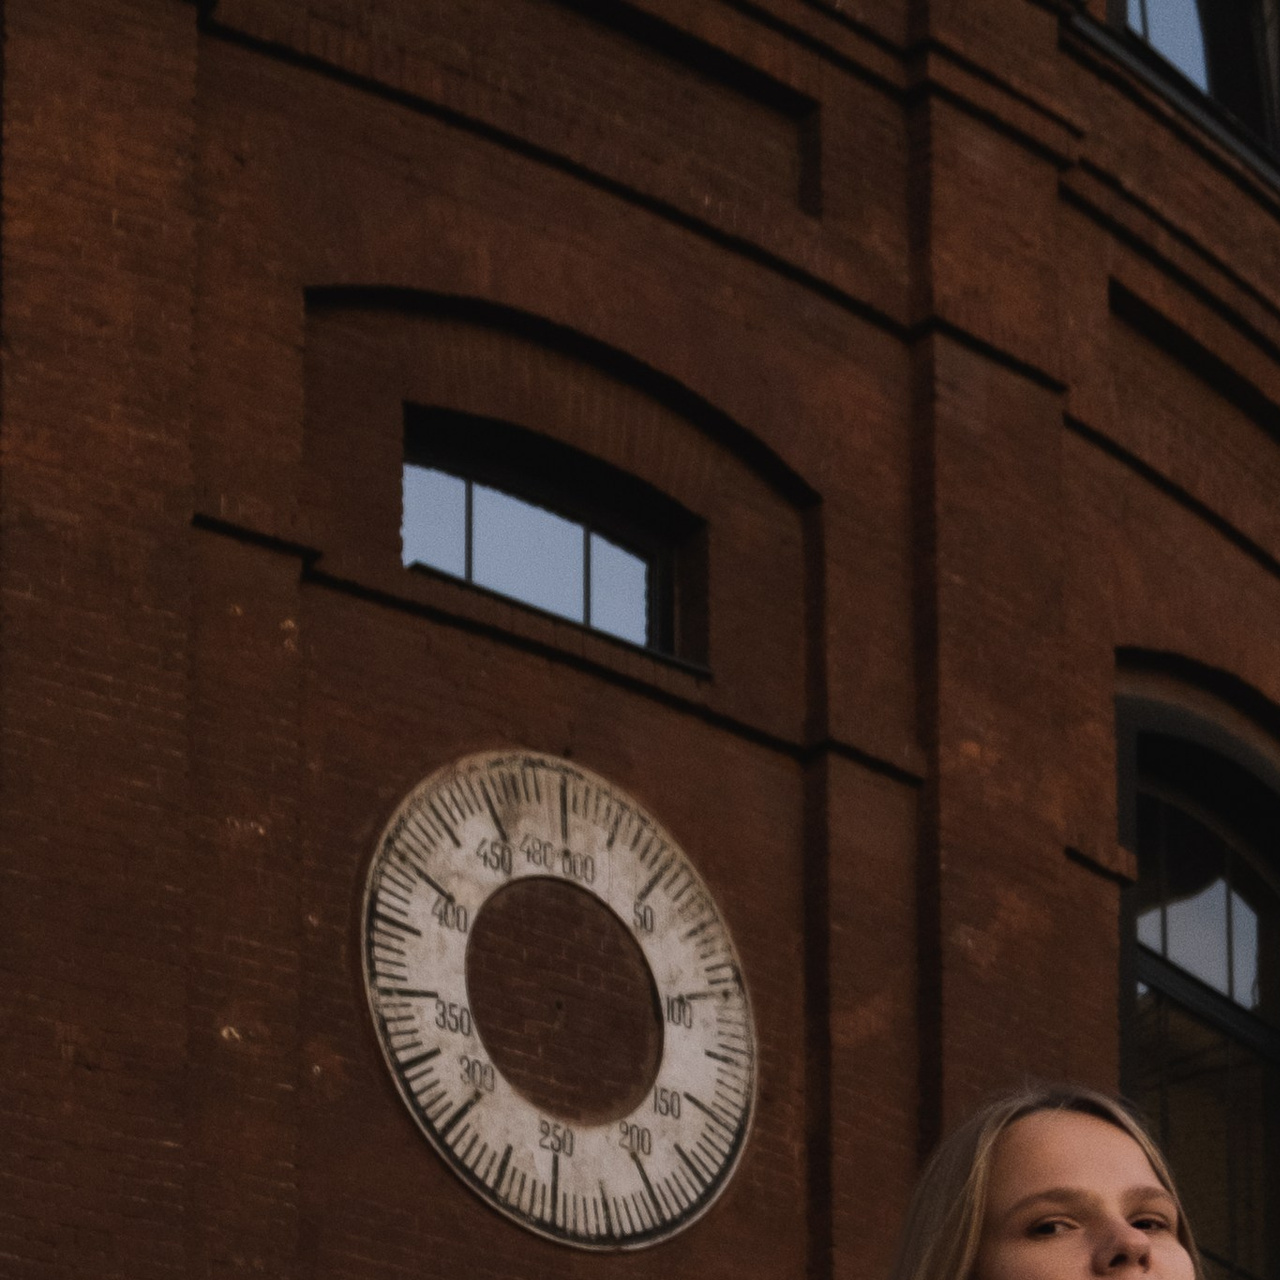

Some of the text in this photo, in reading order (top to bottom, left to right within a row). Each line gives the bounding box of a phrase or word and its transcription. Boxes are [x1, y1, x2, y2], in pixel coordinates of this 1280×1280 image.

[476, 840, 512, 875] 450
[520, 835, 554, 869] 480
[431, 895, 468, 934] 400
[633, 904, 655, 934] 50
[435, 1000, 471, 1037] 350
[666, 997, 692, 1029] 100
[459, 1056, 495, 1092] 300
[653, 1087, 681, 1119] 150
[539, 1120, 573, 1157] 250
[619, 1120, 651, 1156] 200
